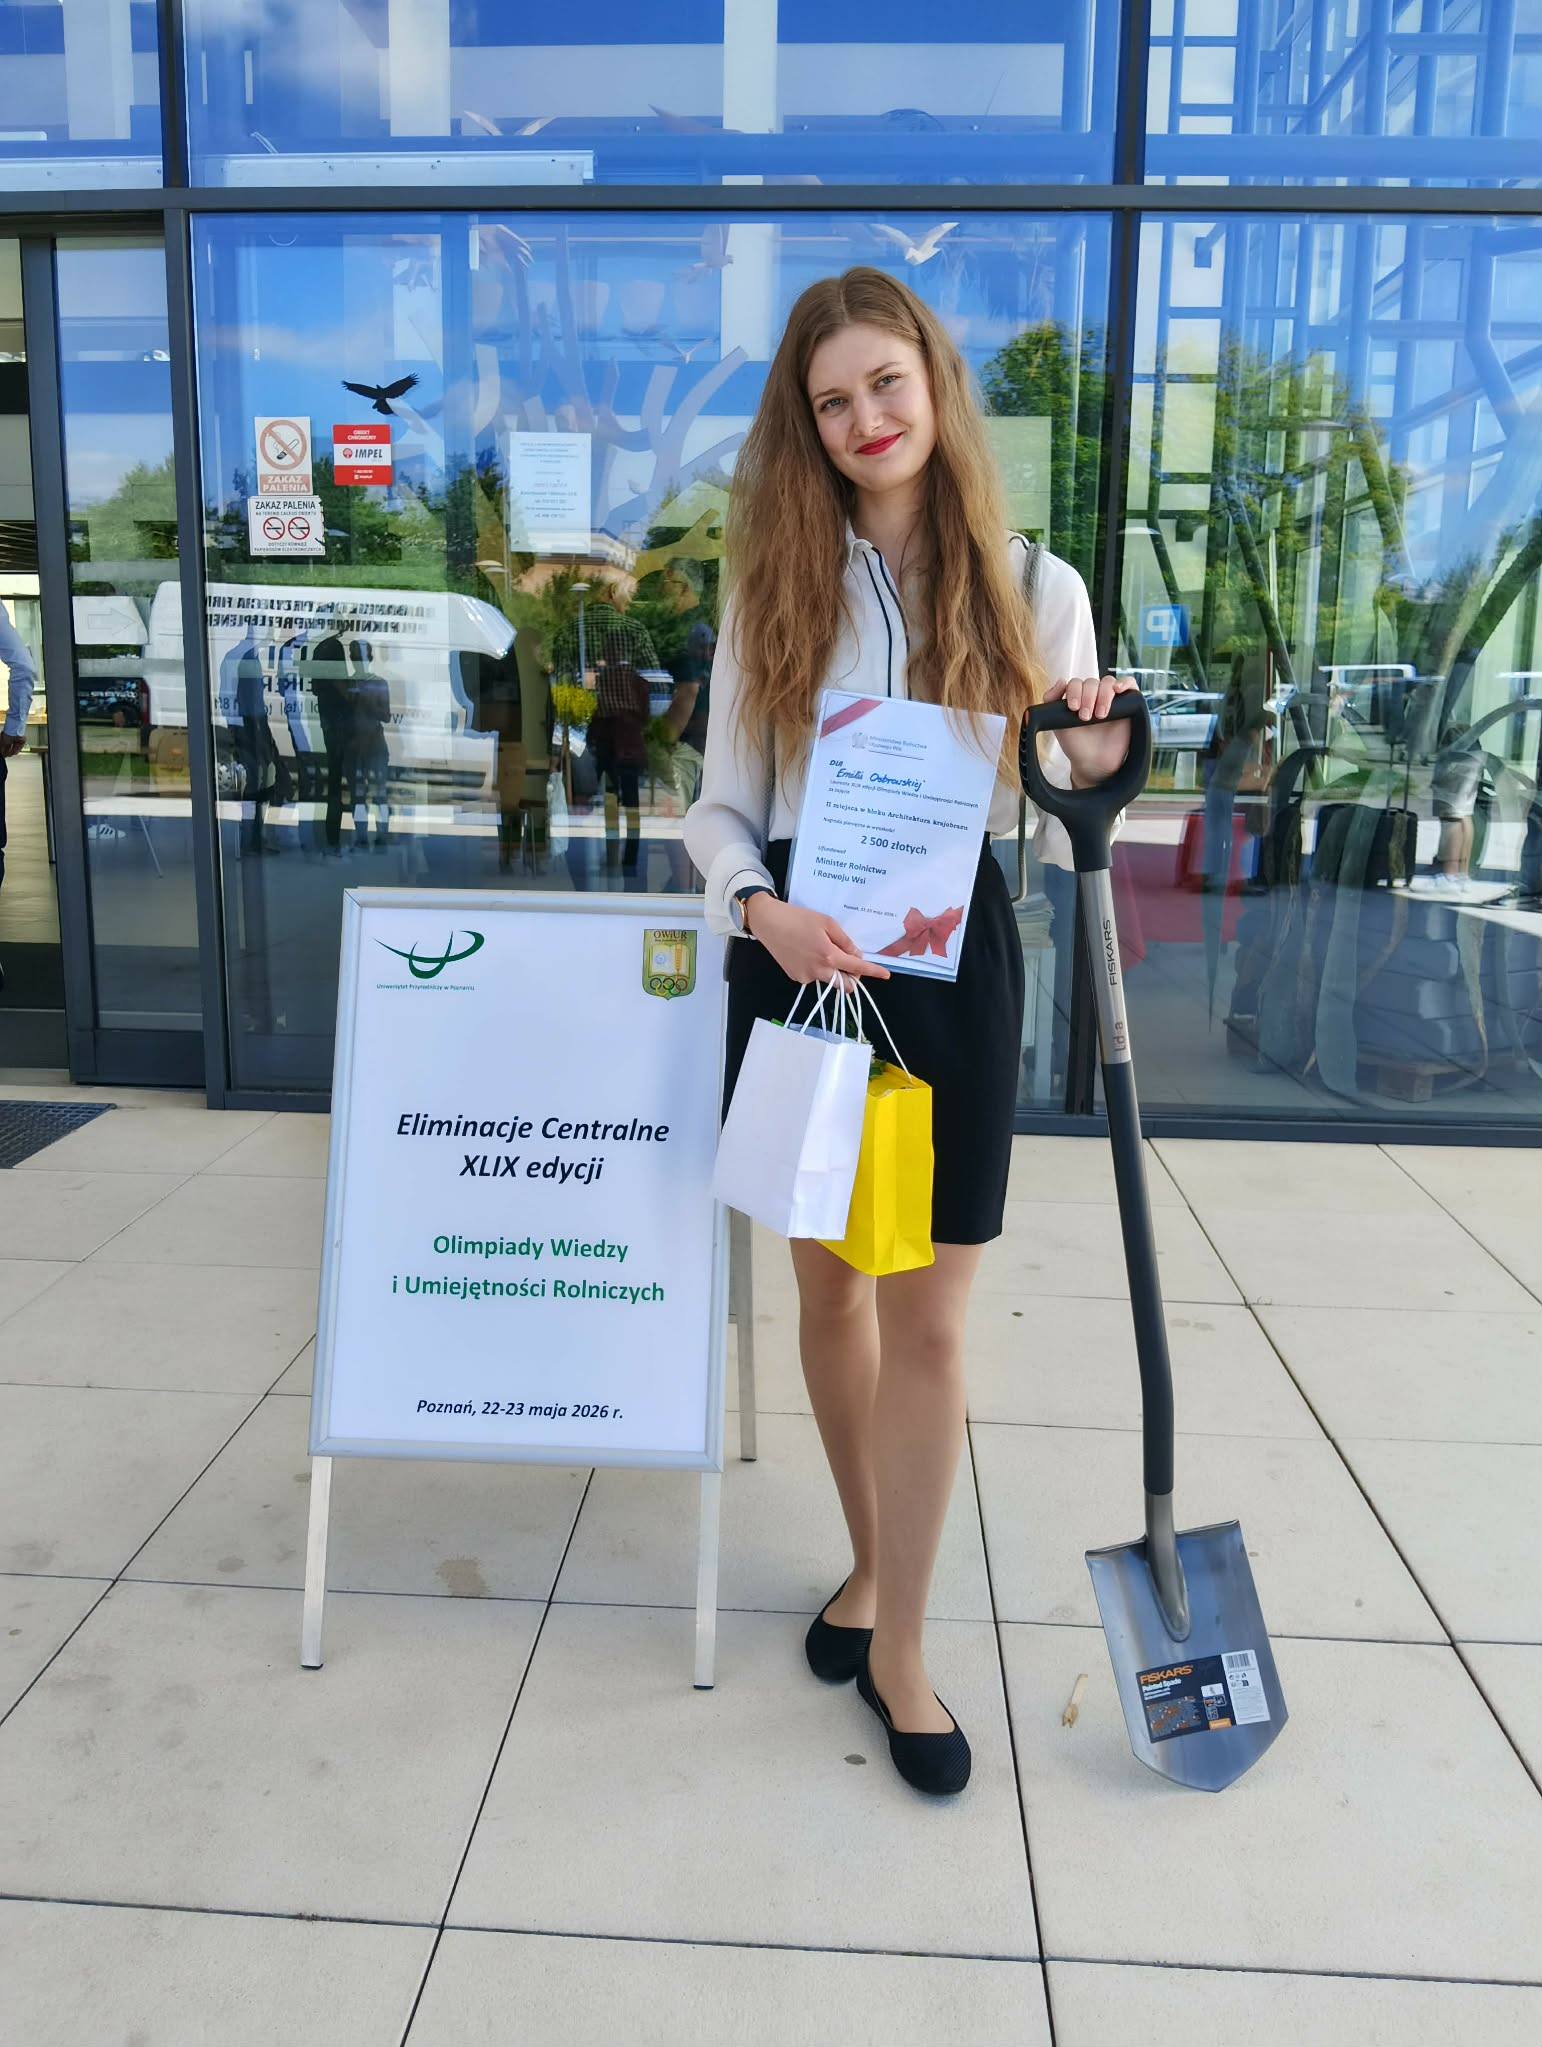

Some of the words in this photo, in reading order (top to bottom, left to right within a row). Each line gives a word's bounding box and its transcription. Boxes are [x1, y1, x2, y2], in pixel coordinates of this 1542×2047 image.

[355, 448, 383, 458] IMPEL
[262, 483, 308, 492] PALENIA
[267, 475, 304, 484] ZAKAZ
[255, 500, 282, 510] ZAKAZ
[283, 500, 316, 510] PALENIA
[887, 811, 931, 825] Architektura
[932, 818, 969, 831] krajobrazu
[860, 835, 868, 845] 2
[869, 836, 889, 848] 500
[890, 840, 927, 856] złotych
[815, 856, 848, 868] Minister
[848, 862, 887, 876] Rolnictwa
[817, 870, 850, 883] Rozwoju
[851, 875, 866, 885] Wsi
[1102, 918, 1118, 986] FISKARS
[376, 983, 408, 992] Uniwersytet
[397, 1113, 533, 1143] Eliminacje
[541, 1117, 670, 1142] Centralne
[459, 1155, 520, 1178] XLIX
[526, 1156, 604, 1185] edycji
[433, 1235, 544, 1260] Olimpiady
[550, 1238, 628, 1263] Wiedzy
[392, 1275, 398, 1294] i
[405, 1276, 546, 1299] Umiejętności
[553, 1279, 665, 1305] Rolniczych
[416, 1399, 477, 1416] Poznań,
[481, 1401, 524, 1416] 22-23
[528, 1403, 567, 1419] maja
[571, 1404, 609, 1418] 2026
[612, 1408, 624, 1419] r.
[1140, 1665, 1193, 1684] FISKARS
